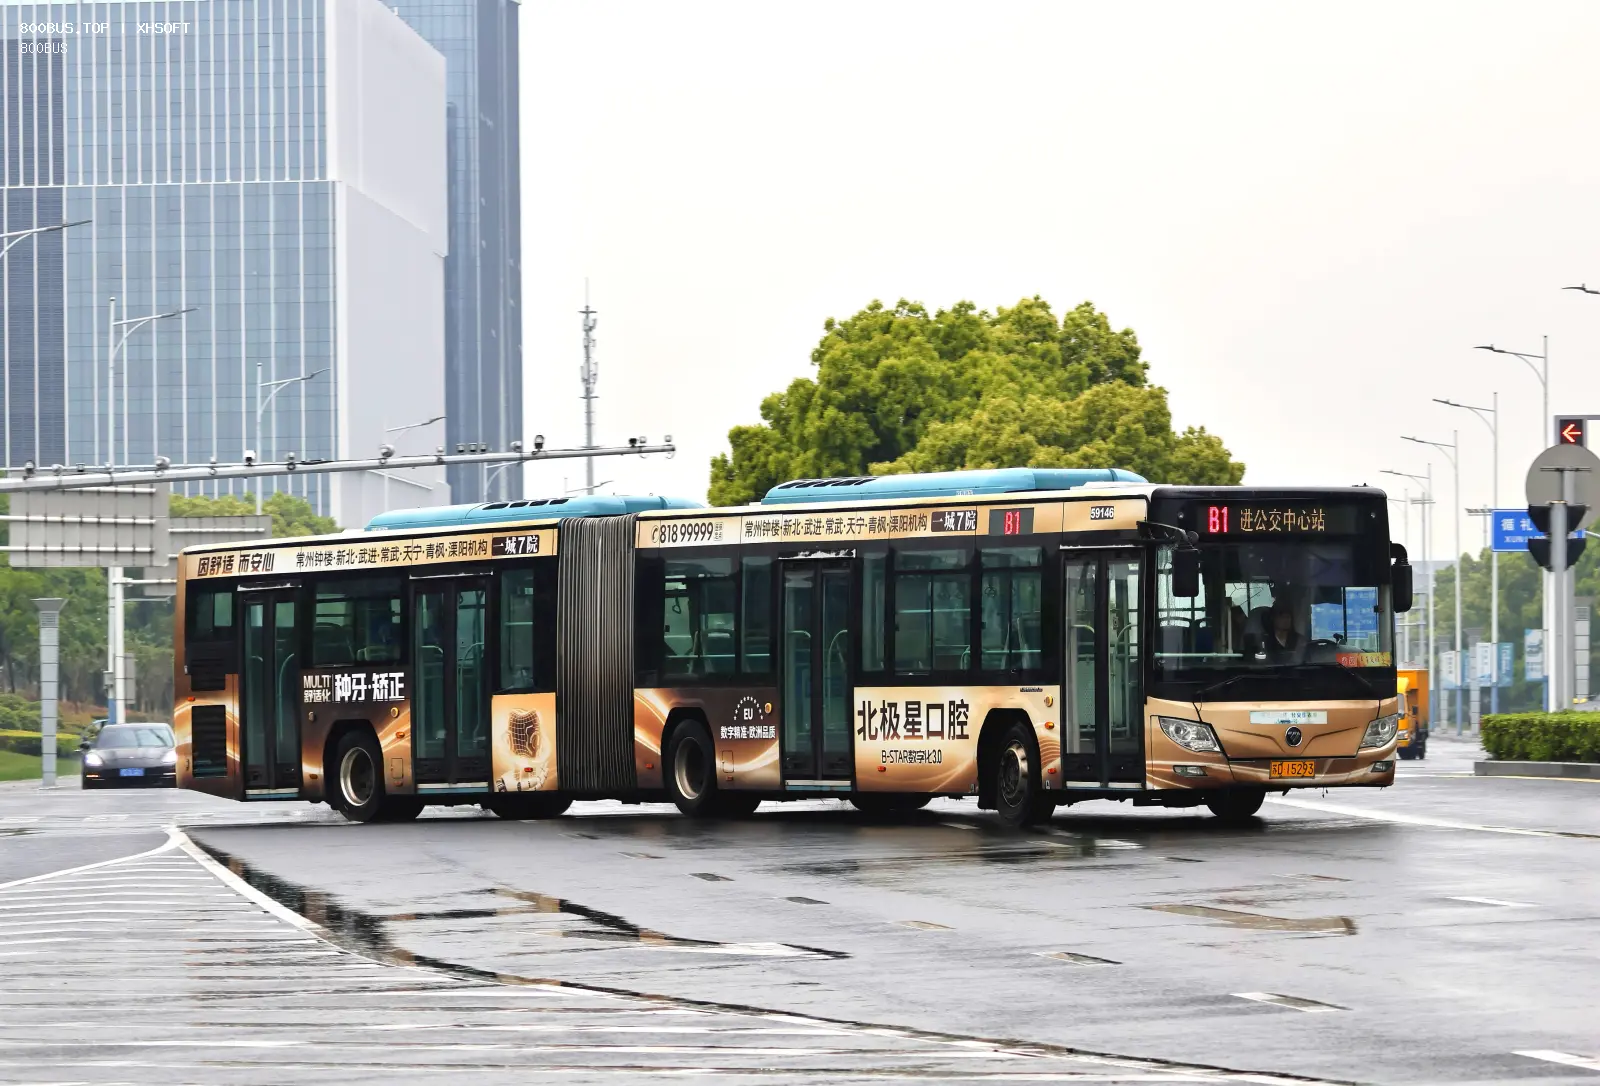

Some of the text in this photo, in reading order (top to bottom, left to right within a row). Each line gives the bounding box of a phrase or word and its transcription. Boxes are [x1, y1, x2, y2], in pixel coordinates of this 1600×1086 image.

[931, 511, 977, 531] 一城7院
[1090, 507, 1114, 519] 59146
[1209, 506, 1229, 533] B1
[1240, 509, 1325, 532] 进公交中心站
[493, 536, 540, 554] 一城7院
[197, 553, 275, 577] 因舒适 而安心
[303, 675, 331, 688] MULTI
[303, 689, 331, 703] 舒适化
[743, 708, 753, 720] EU
[857, 699, 969, 742] 北极星口腔
